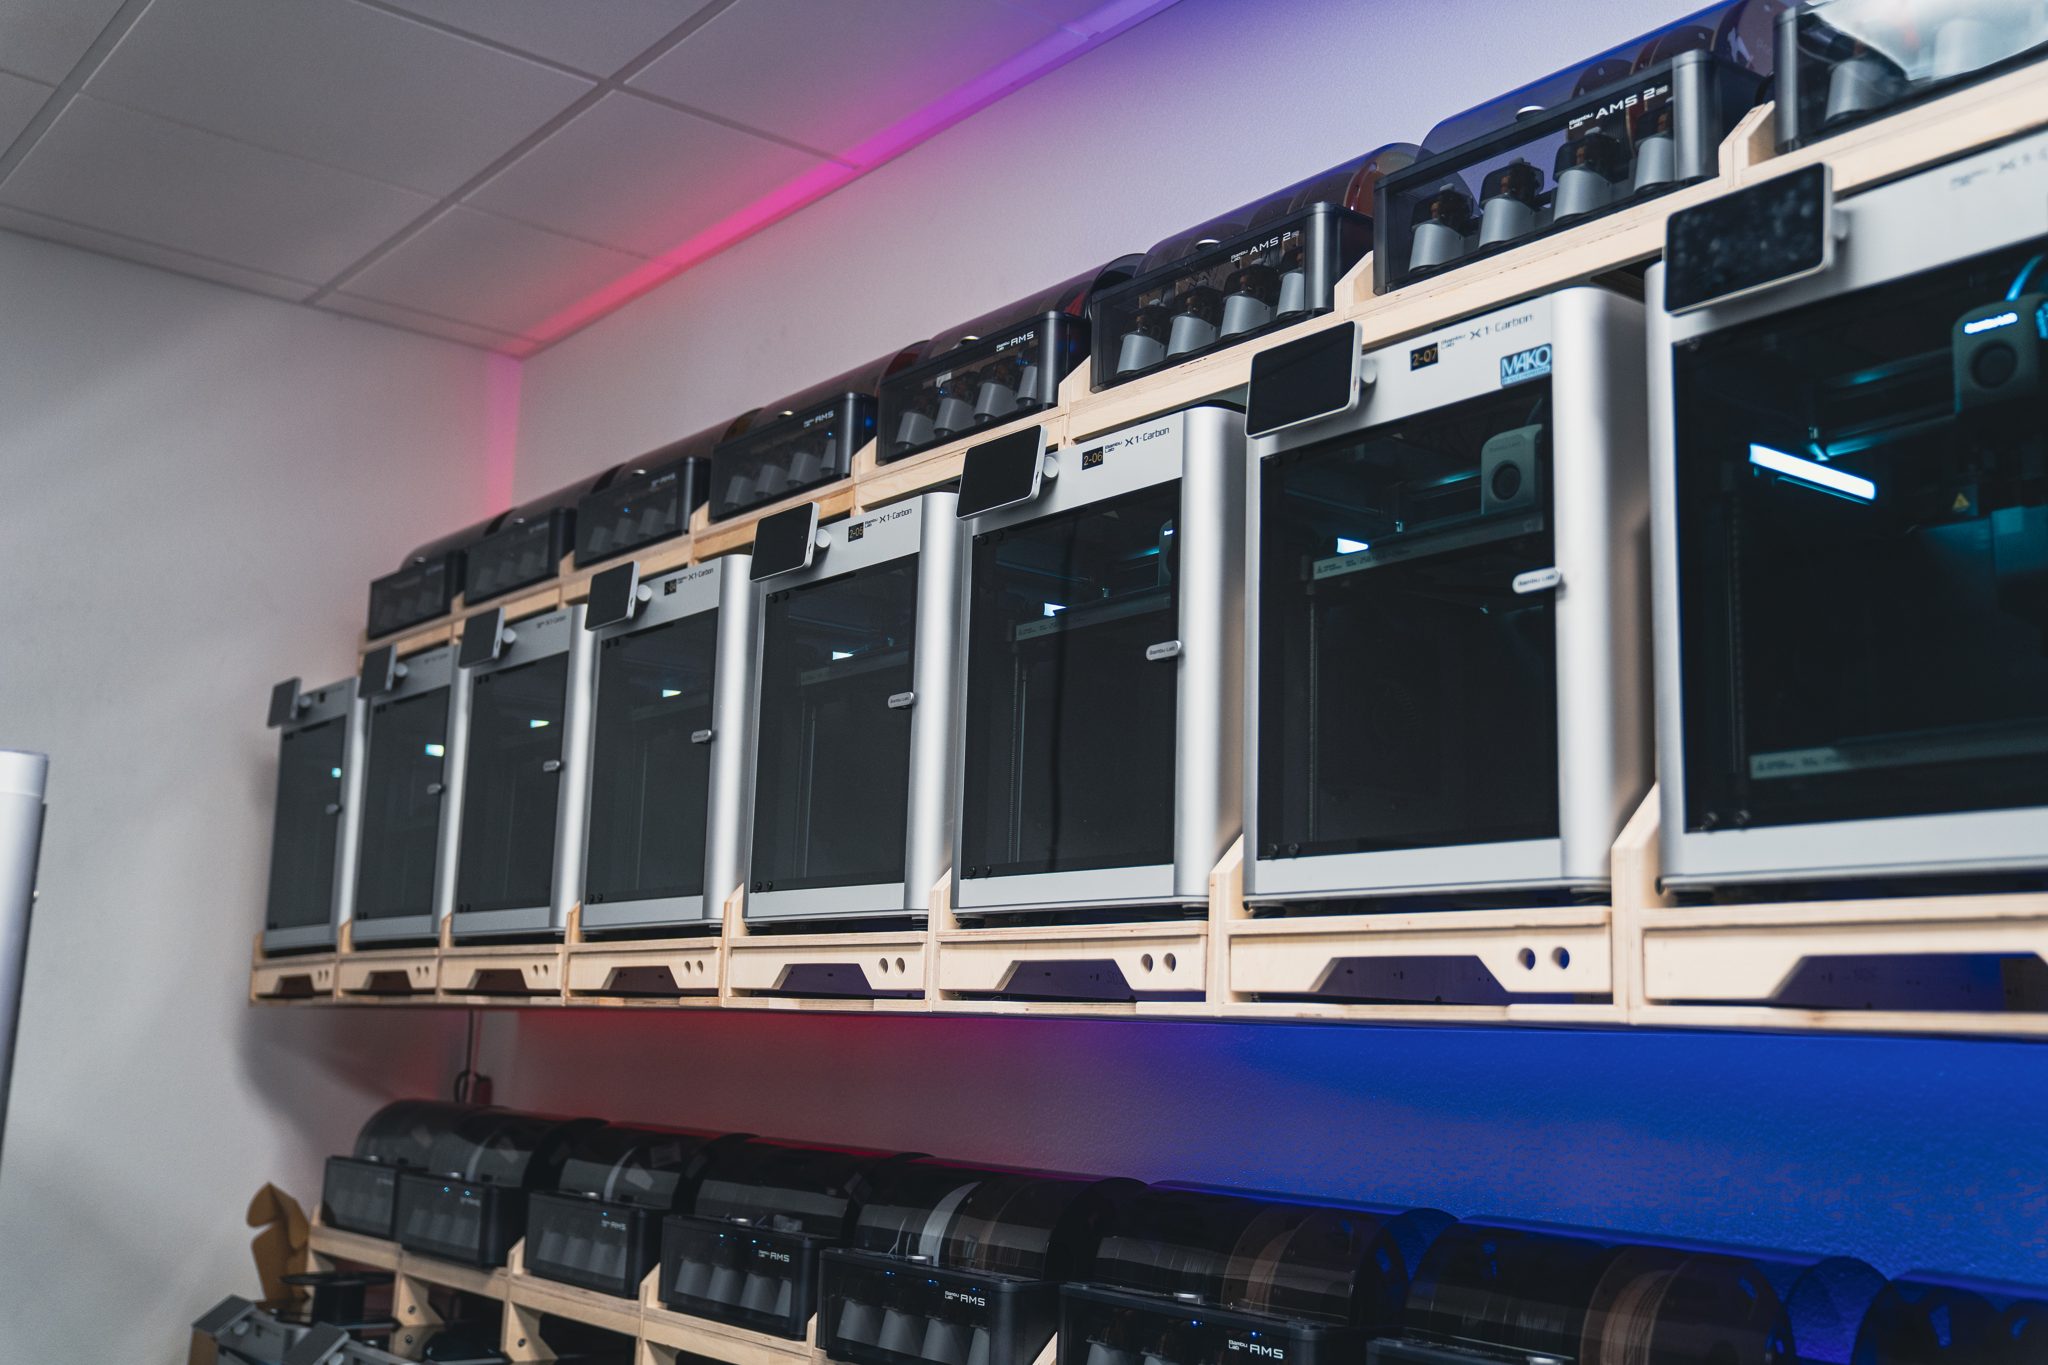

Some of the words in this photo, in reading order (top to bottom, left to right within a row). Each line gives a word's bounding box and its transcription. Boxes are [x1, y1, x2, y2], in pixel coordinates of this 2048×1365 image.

[1596, 94, 1638, 119] AMS
[1643, 87, 1655, 100] 2
[1249, 236, 1279, 255] AMS
[1282, 231, 1291, 241] 2
[1010, 330, 1034, 347] AMS
[1412, 347, 1437, 366] 2-07
[1501, 346, 1551, 377] MAKO
[1083, 451, 1103, 466] 2-06
[770, 1251, 790, 1263] AMS
[960, 1294, 986, 1306] AMS
[1249, 1343, 1284, 1360] AMS
